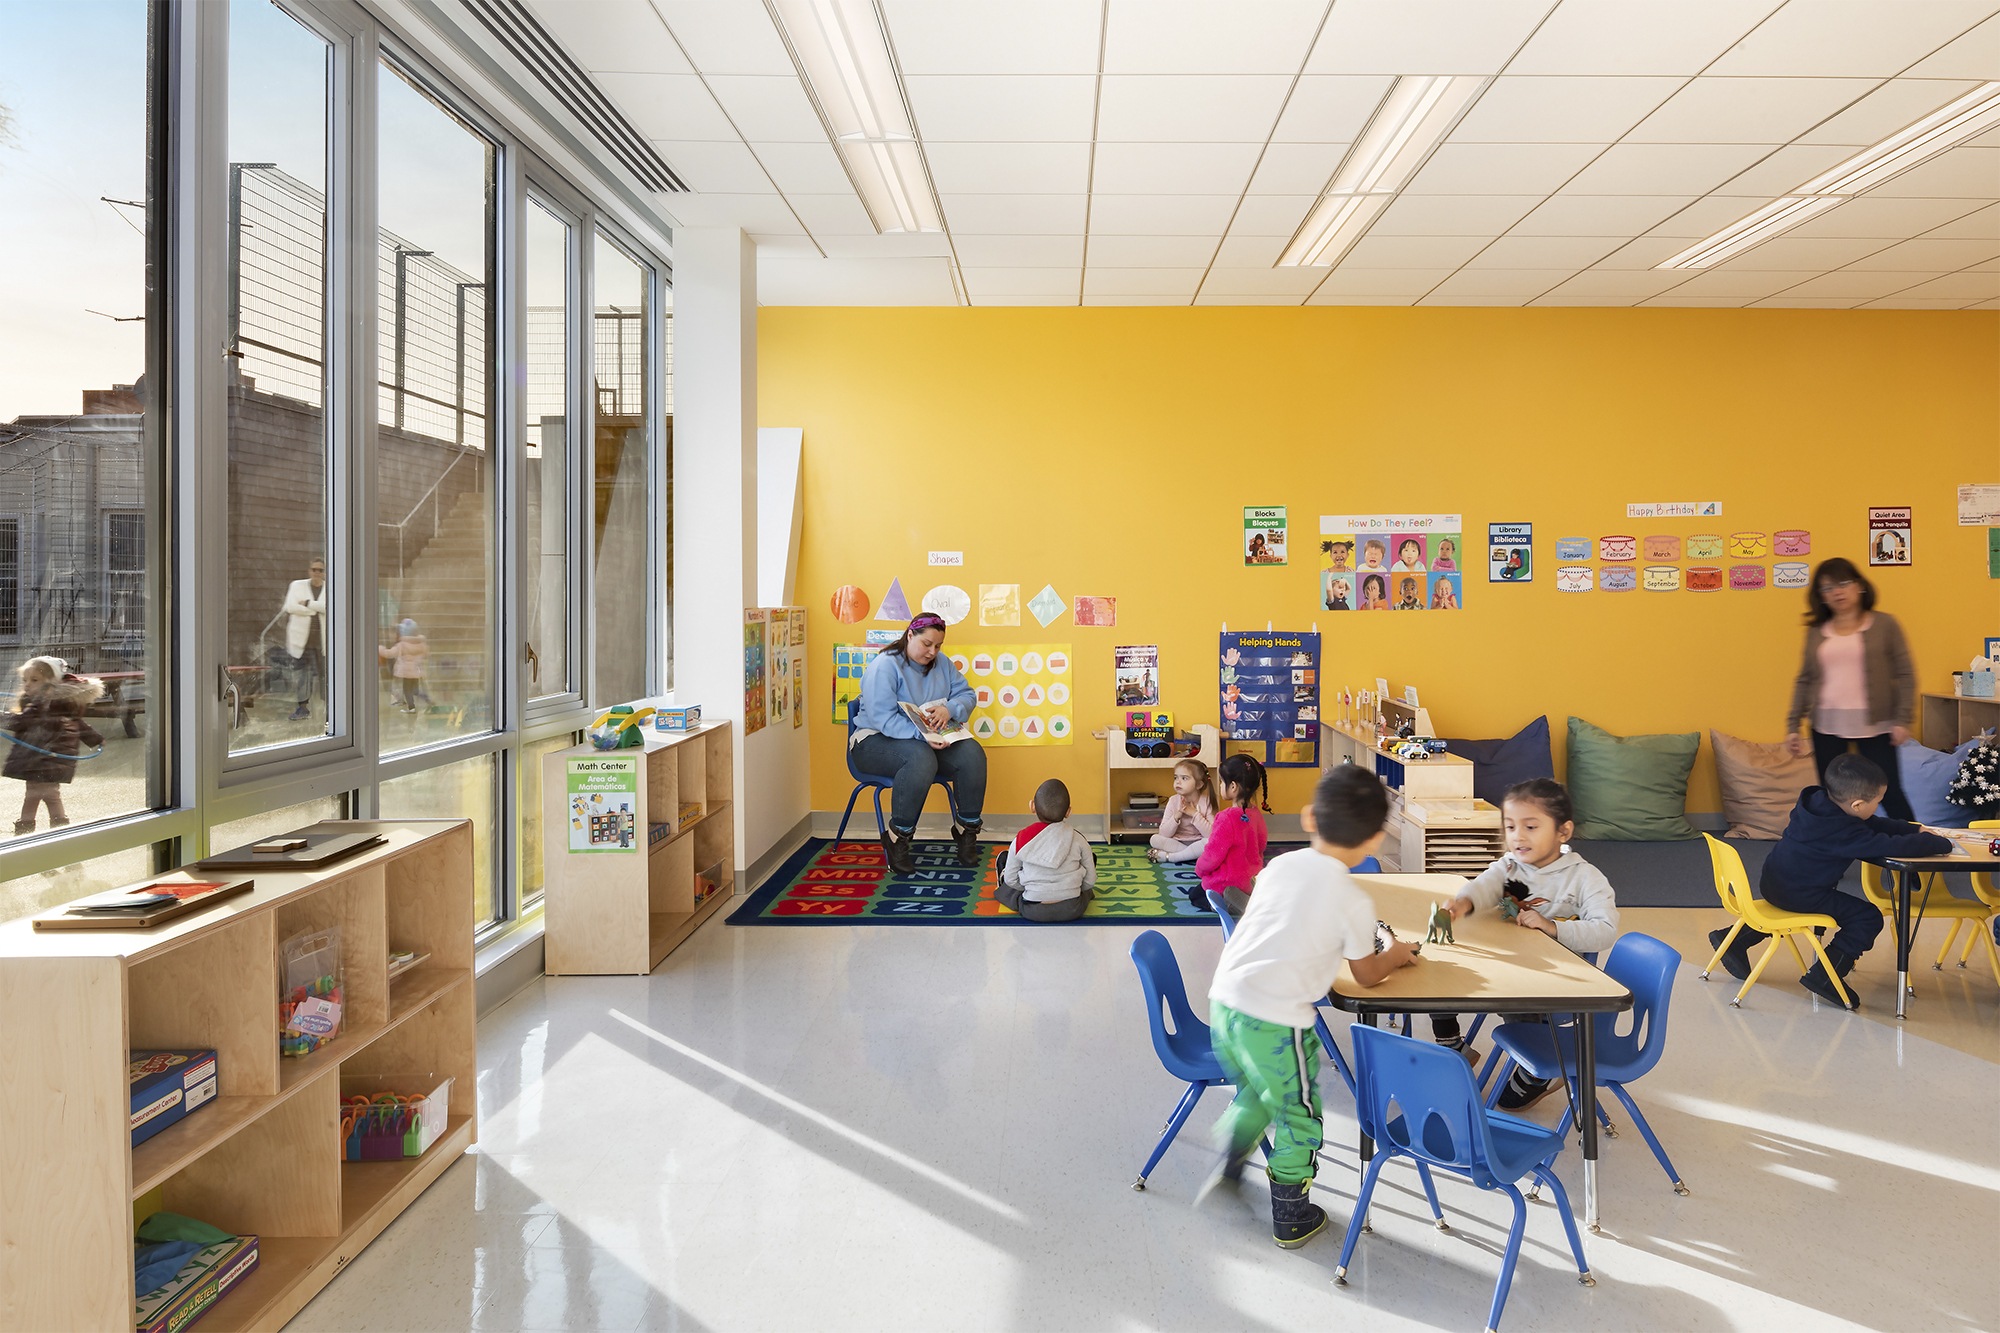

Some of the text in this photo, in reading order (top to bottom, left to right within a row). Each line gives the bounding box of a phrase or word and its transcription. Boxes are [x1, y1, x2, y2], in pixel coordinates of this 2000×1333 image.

[1629, 505, 1654, 517] Happy
[1385, 519, 1406, 528] They
[1409, 519, 1433, 527] Feel?
[930, 552, 960, 565] Shapes
[931, 597, 950, 609] Oval
[1239, 638, 1301, 647] Helping Hands
[830, 854, 880, 865] Gg
[809, 870, 879, 878] Mm
[908, 870, 960, 879] Nn
[808, 886, 855, 894] Ss
[910, 886, 948, 895] Tt
[797, 902, 846, 914] Yy
[893, 902, 943, 912] Zz
[162, 1095, 177, 1108] Center
[220, 1255, 254, 1288] Descriptive Words
[169, 1307, 188, 1331] READ
[189, 1302, 194, 1311] &
[195, 1284, 217, 1306] RETELL
